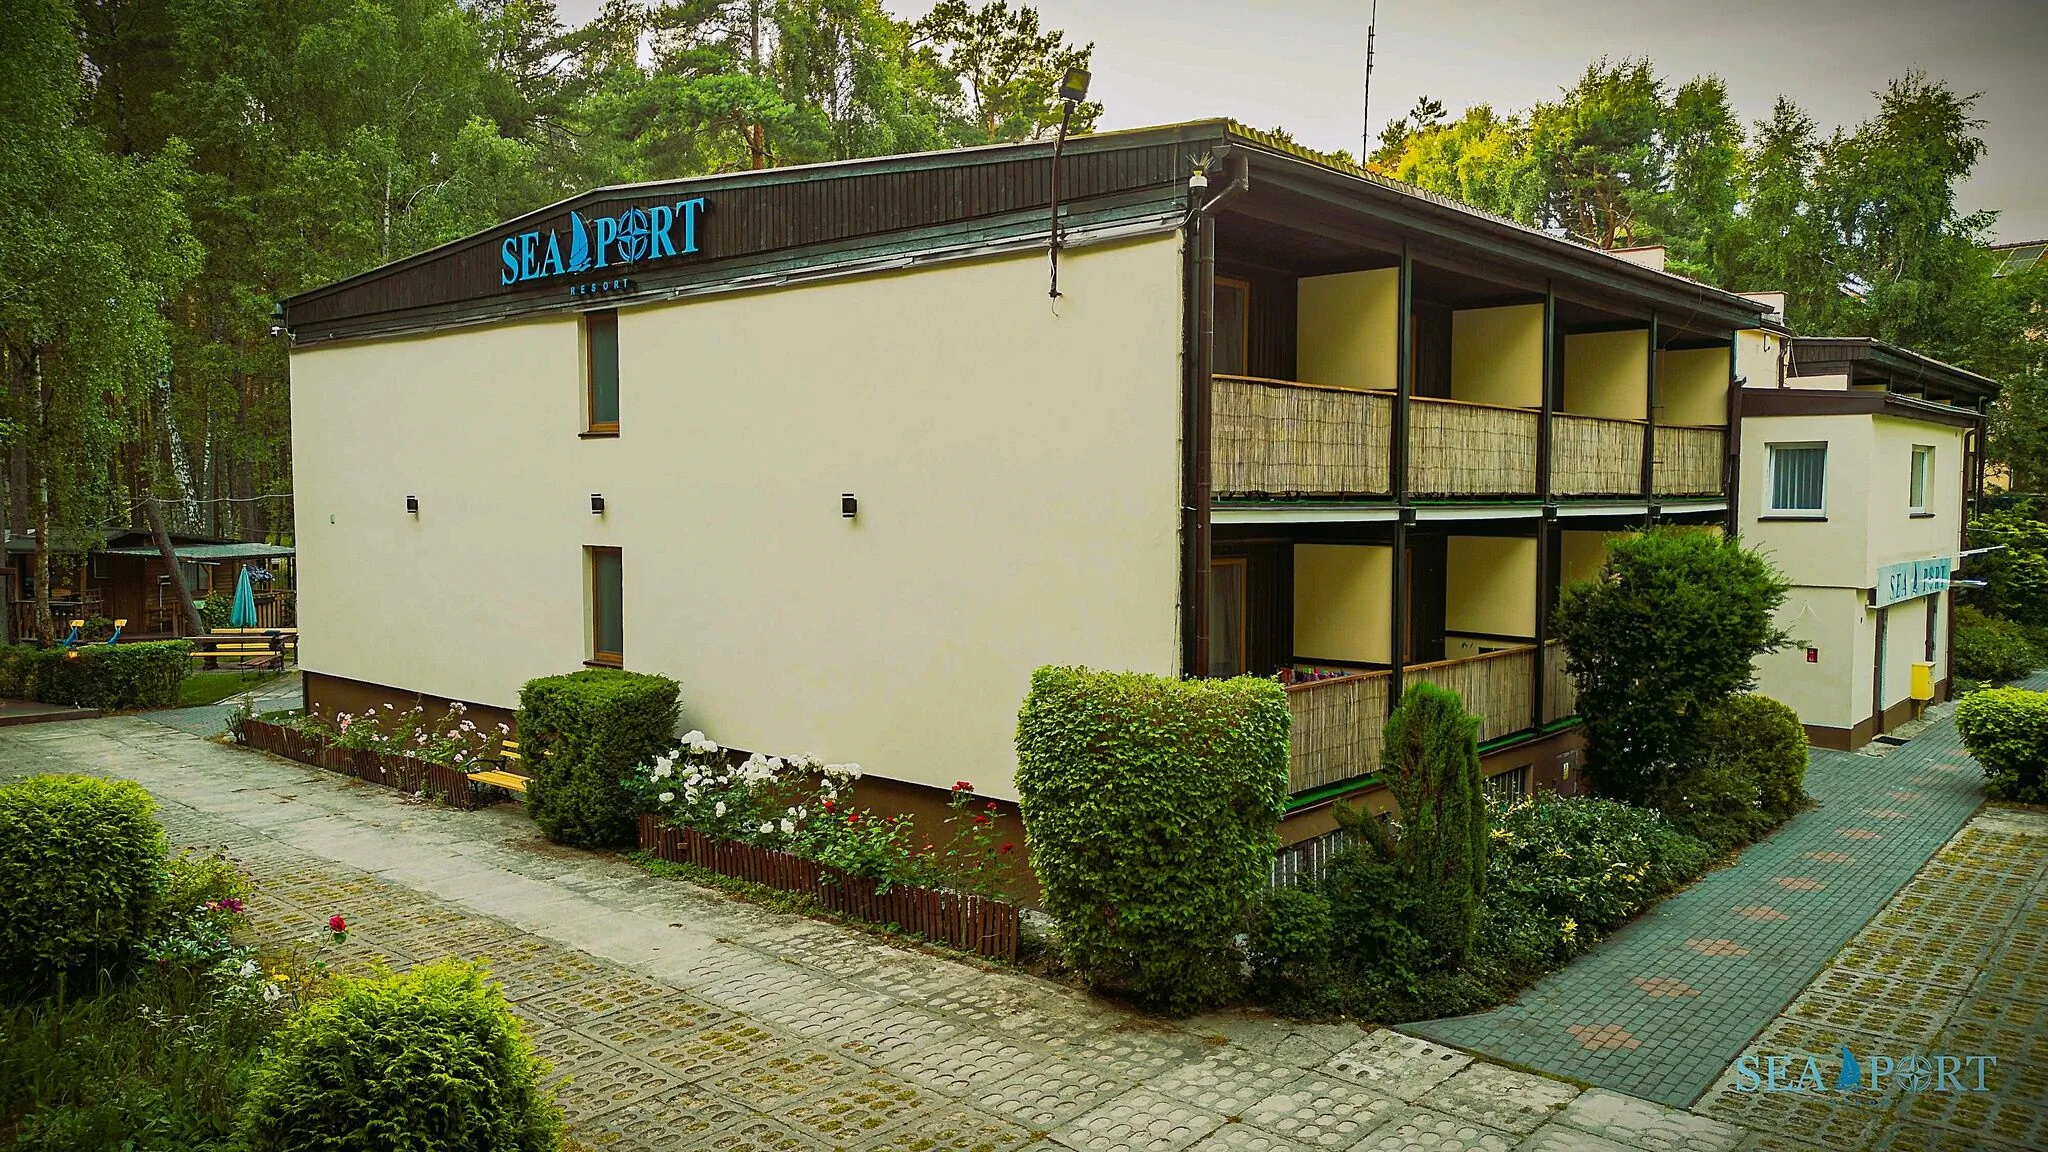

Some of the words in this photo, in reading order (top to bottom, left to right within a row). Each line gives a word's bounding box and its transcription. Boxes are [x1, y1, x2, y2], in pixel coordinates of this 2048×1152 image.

[501, 228, 566, 287] SEA
[570, 278, 628, 296] RESORT
[1889, 571, 1907, 600] SEA
